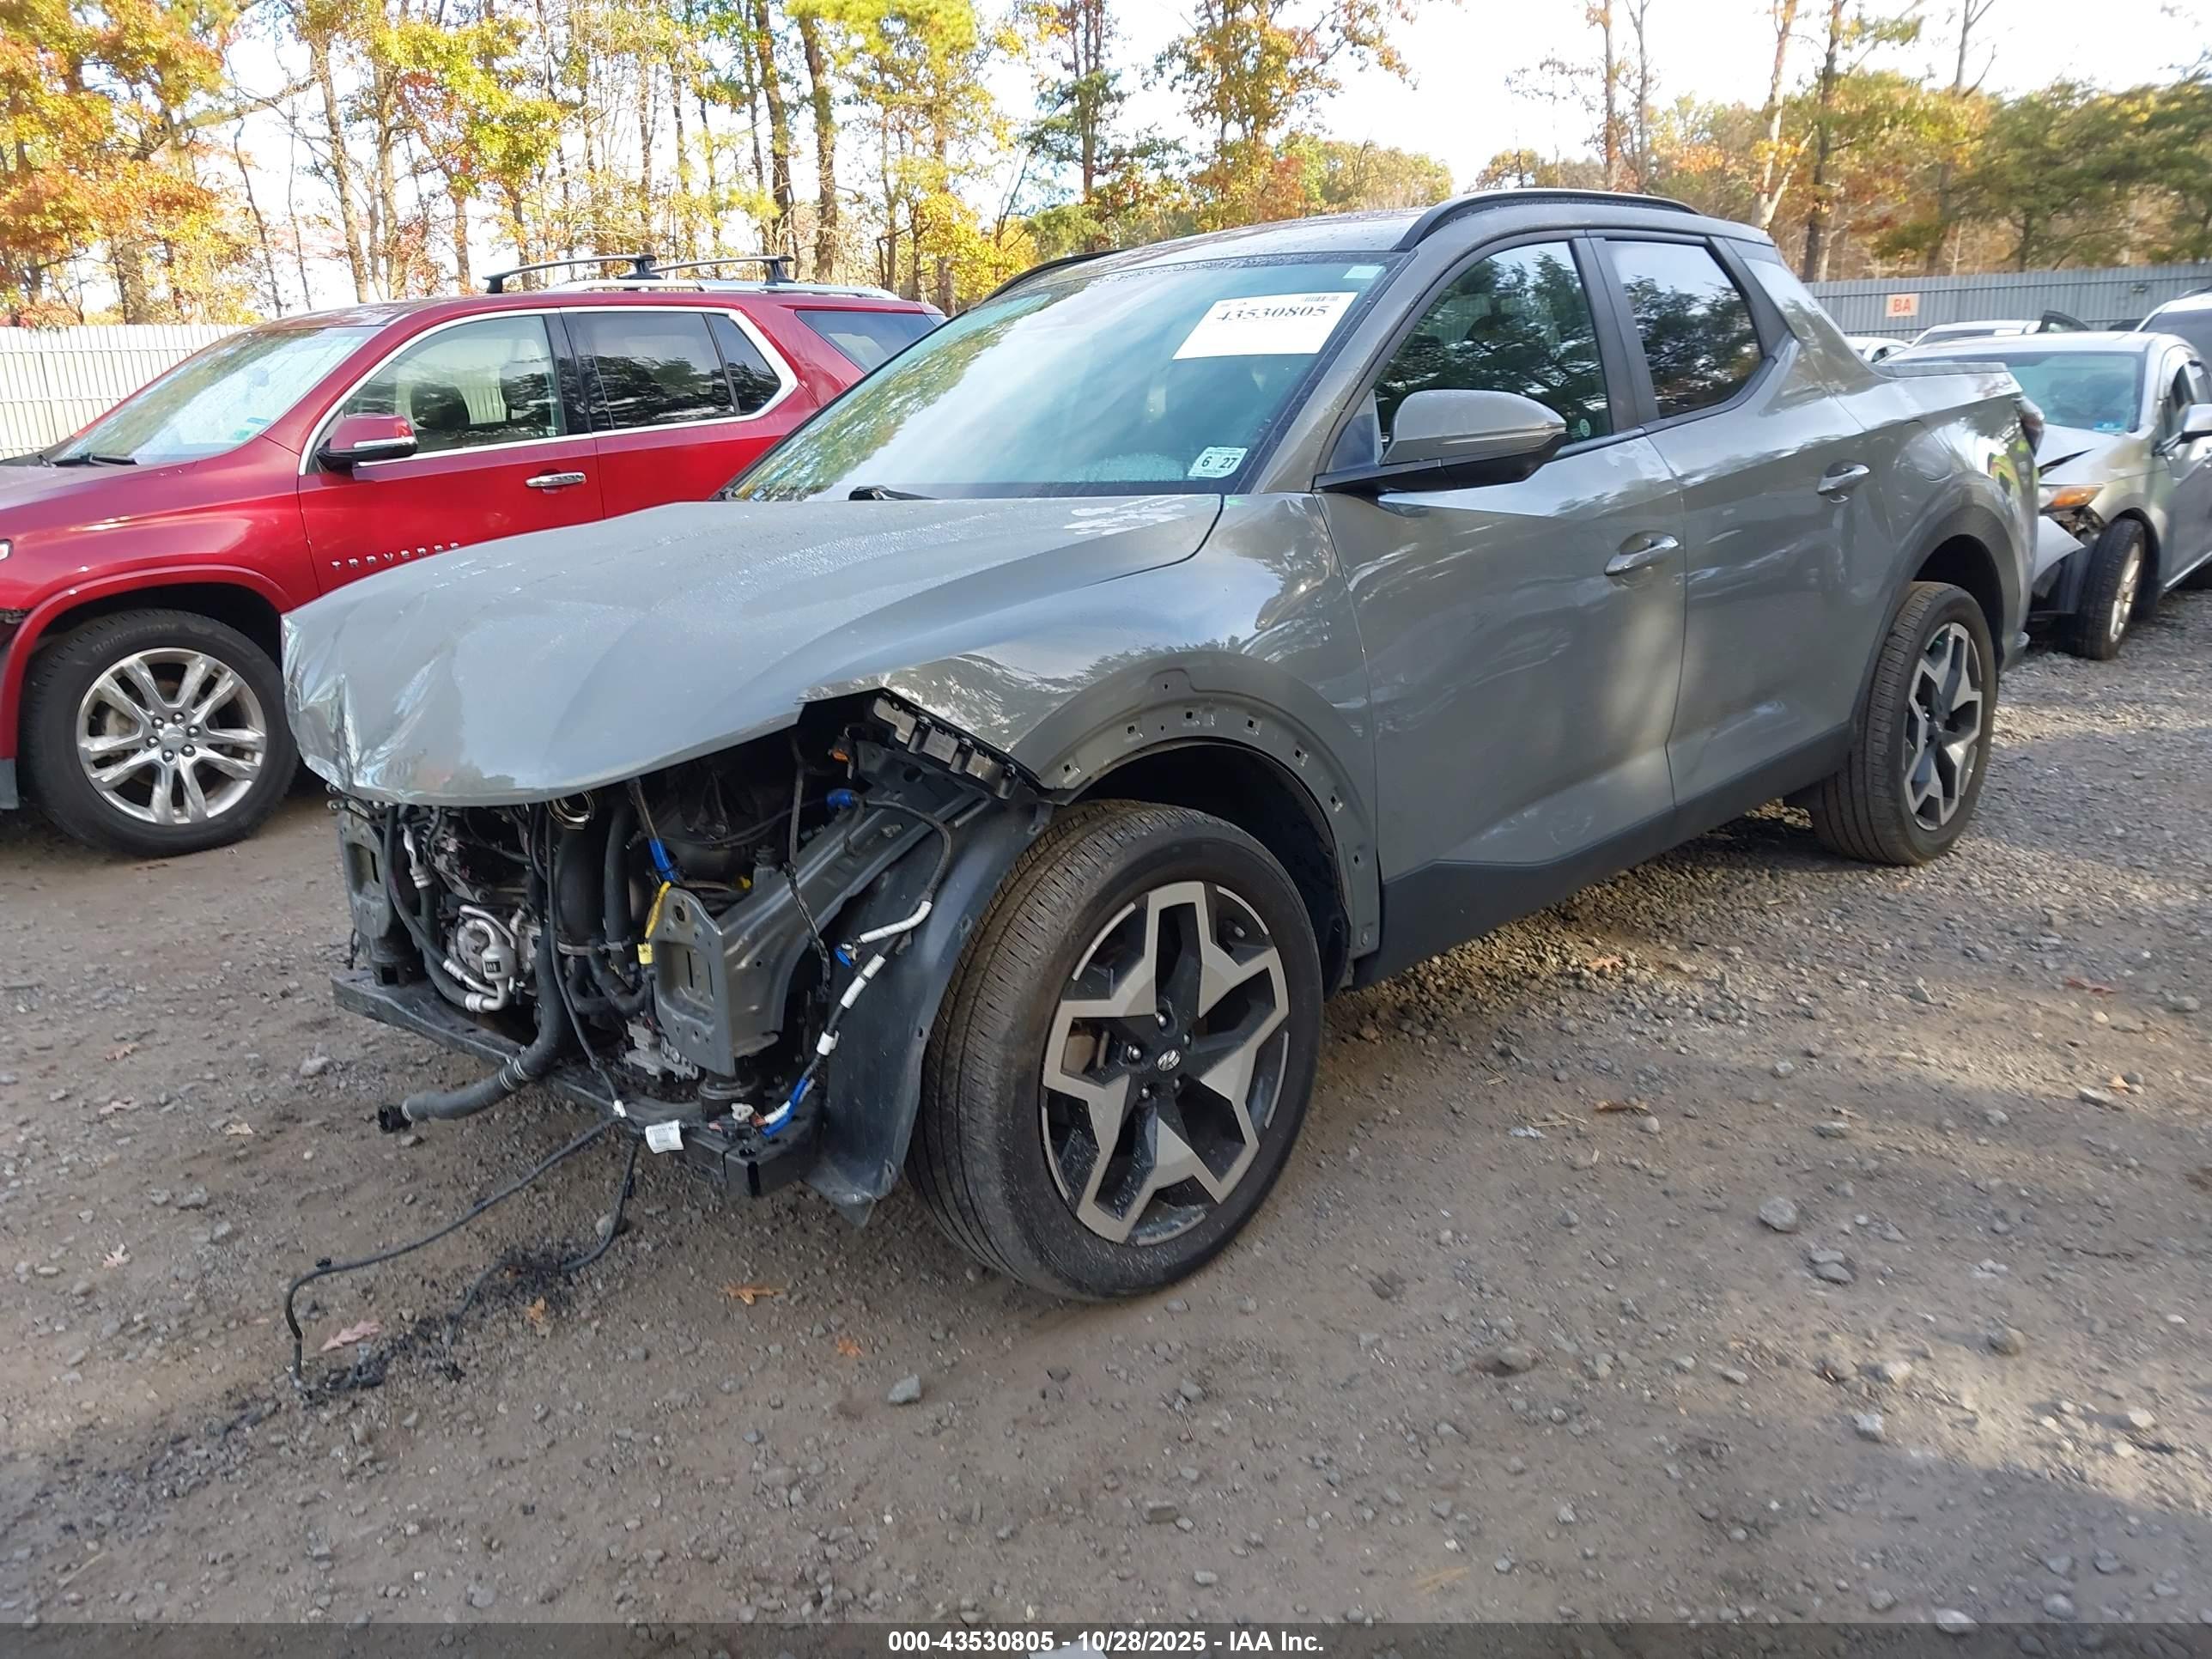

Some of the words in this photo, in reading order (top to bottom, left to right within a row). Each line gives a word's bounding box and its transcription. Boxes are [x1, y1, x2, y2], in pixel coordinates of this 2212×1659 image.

[1893, 298, 1911, 313] BA
[1216, 306, 1330, 320] 43530805
[1201, 456, 1212, 467] 6
[1218, 457, 1238, 468] 27
